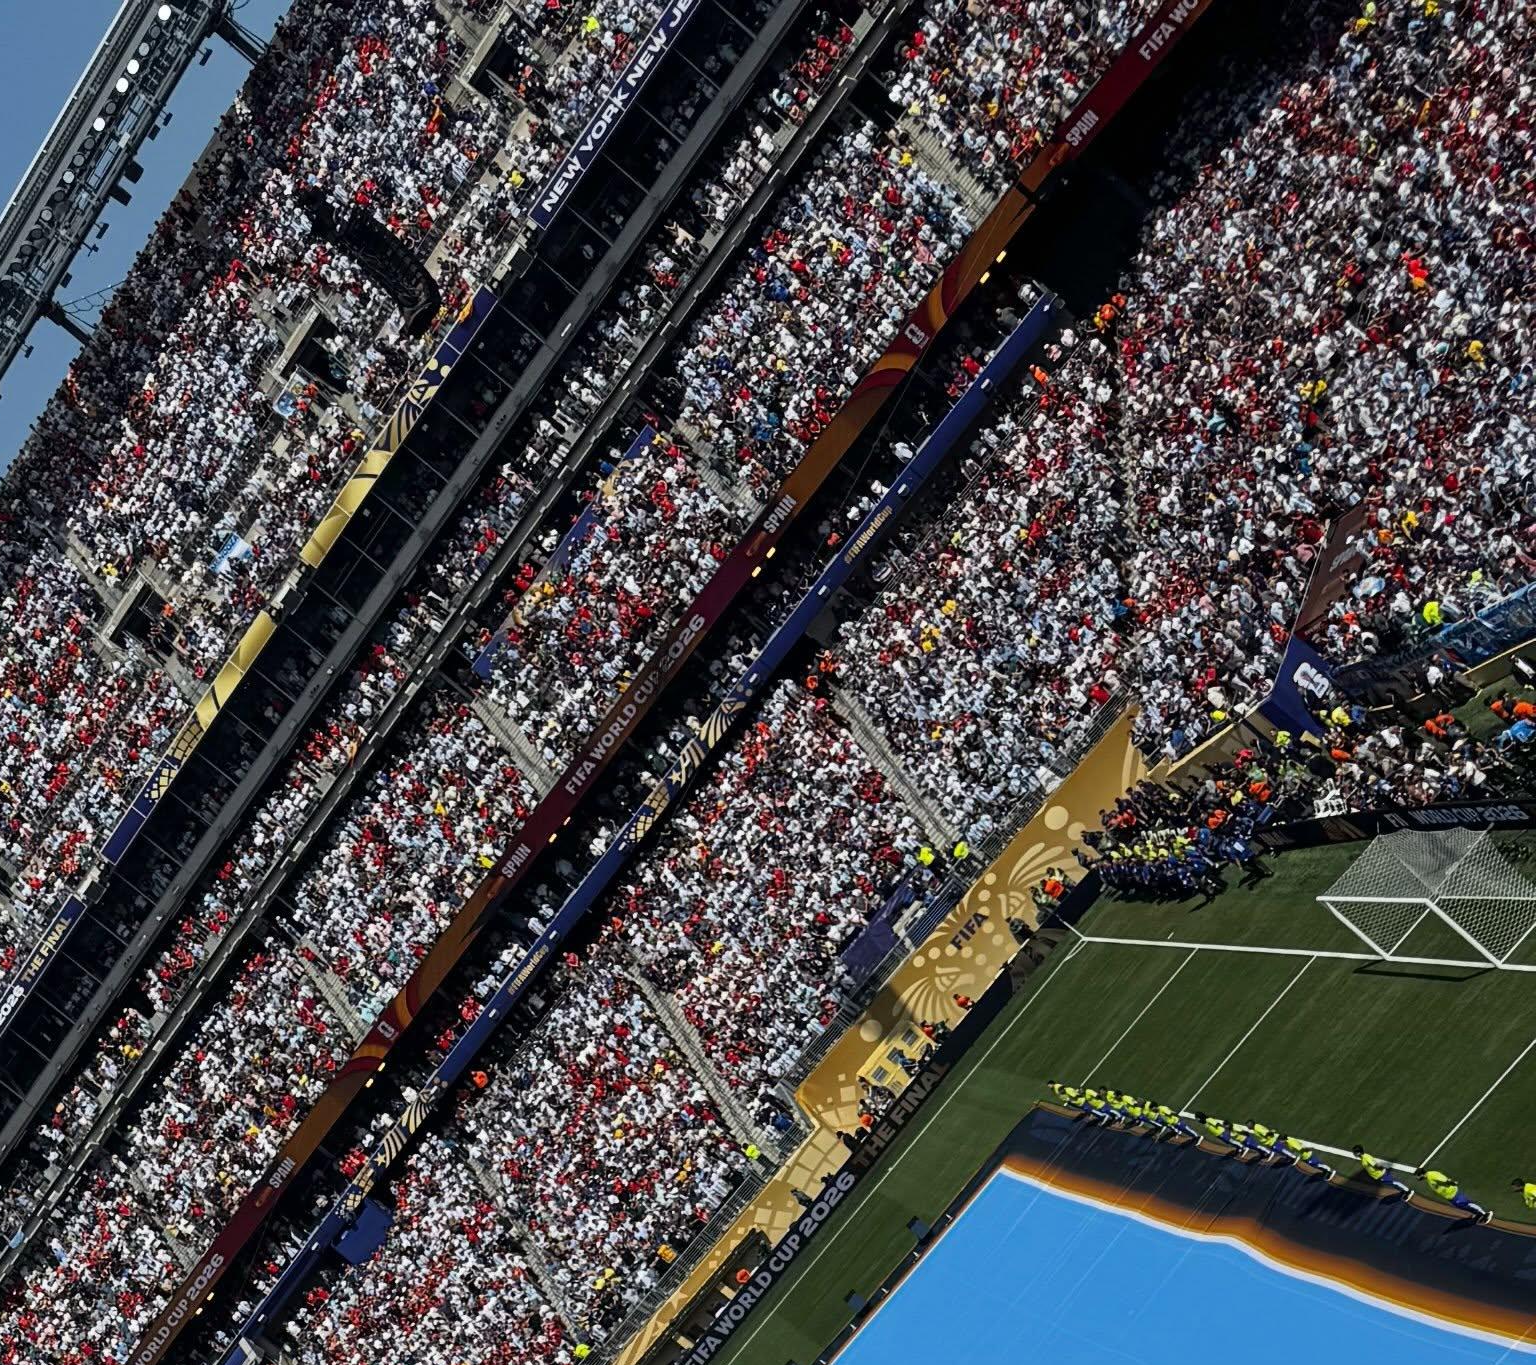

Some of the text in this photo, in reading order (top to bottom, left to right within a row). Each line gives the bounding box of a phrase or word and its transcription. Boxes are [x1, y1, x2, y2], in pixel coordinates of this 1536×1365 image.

[1137, 19, 1177, 62] FIFA
[540, 26, 670, 214] NEW YORK NEW
[1063, 108, 1101, 148] SPAIN
[761, 494, 798, 536] SPAIN
[563, 612, 706, 796] FIFA WORLD CUP 2026
[500, 842, 533, 880] SPAIN
[19, 954, 45, 986] THE
[38, 914, 72, 958] FINAL
[949, 909, 988, 953] FIFA
[849, 1060, 946, 1173] THE FINAL
[267, 1155, 298, 1189] SPAIN
[711, 1268, 775, 1339] WORLD
[765, 1232, 806, 1276] CUP
[795, 1169, 859, 1239] 2026
[164, 1297, 191, 1329] CUP
[183, 1251, 225, 1302] 2026
